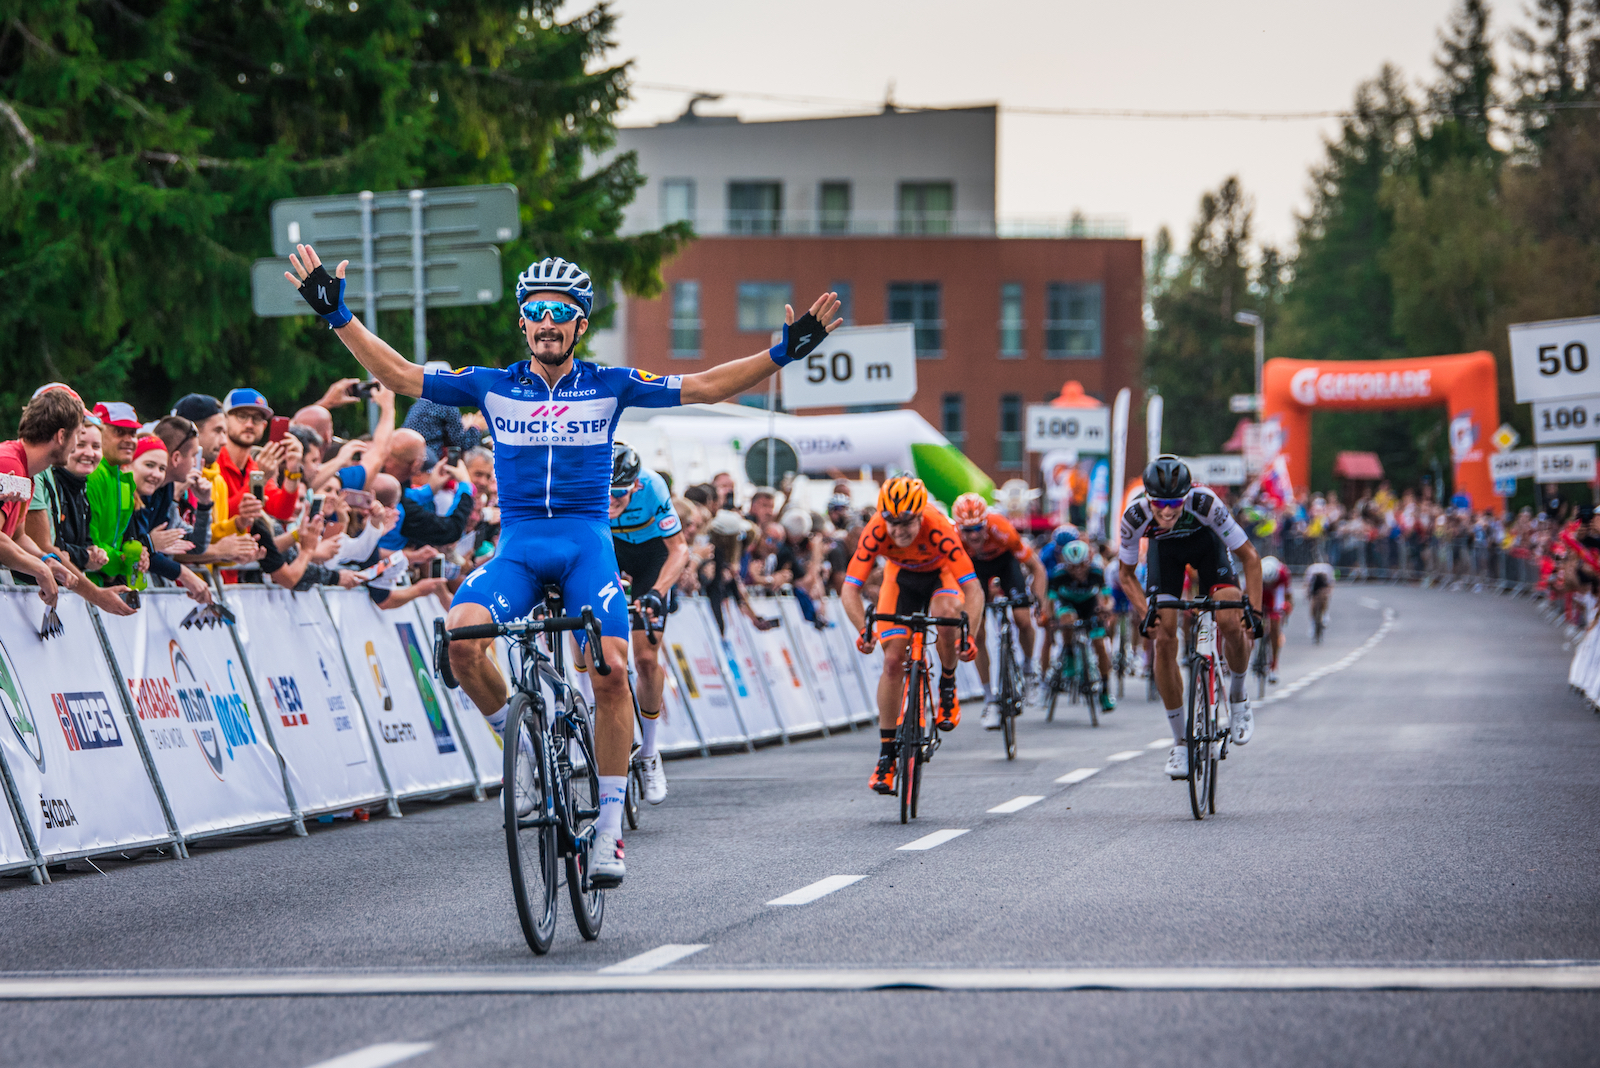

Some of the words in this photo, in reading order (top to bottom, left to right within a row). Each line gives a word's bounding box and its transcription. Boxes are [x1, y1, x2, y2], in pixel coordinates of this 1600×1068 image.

[807, 352, 852, 383] 50
[867, 363, 892, 380] m
[1538, 342, 1588, 376] 50
[557, 388, 597, 398] latexco
[1037, 417, 1079, 438] 100
[1542, 406, 1588, 430] 100
[529, 435, 575, 443] FLOORS
[857, 526, 886, 562] CCC
[929, 528, 962, 562] CCC
[127, 677, 180, 720] STRABAG
[176, 688, 213, 723] msm
[68, 698, 118, 743] TIPOS
[38, 793, 80, 830] ŠKODA
